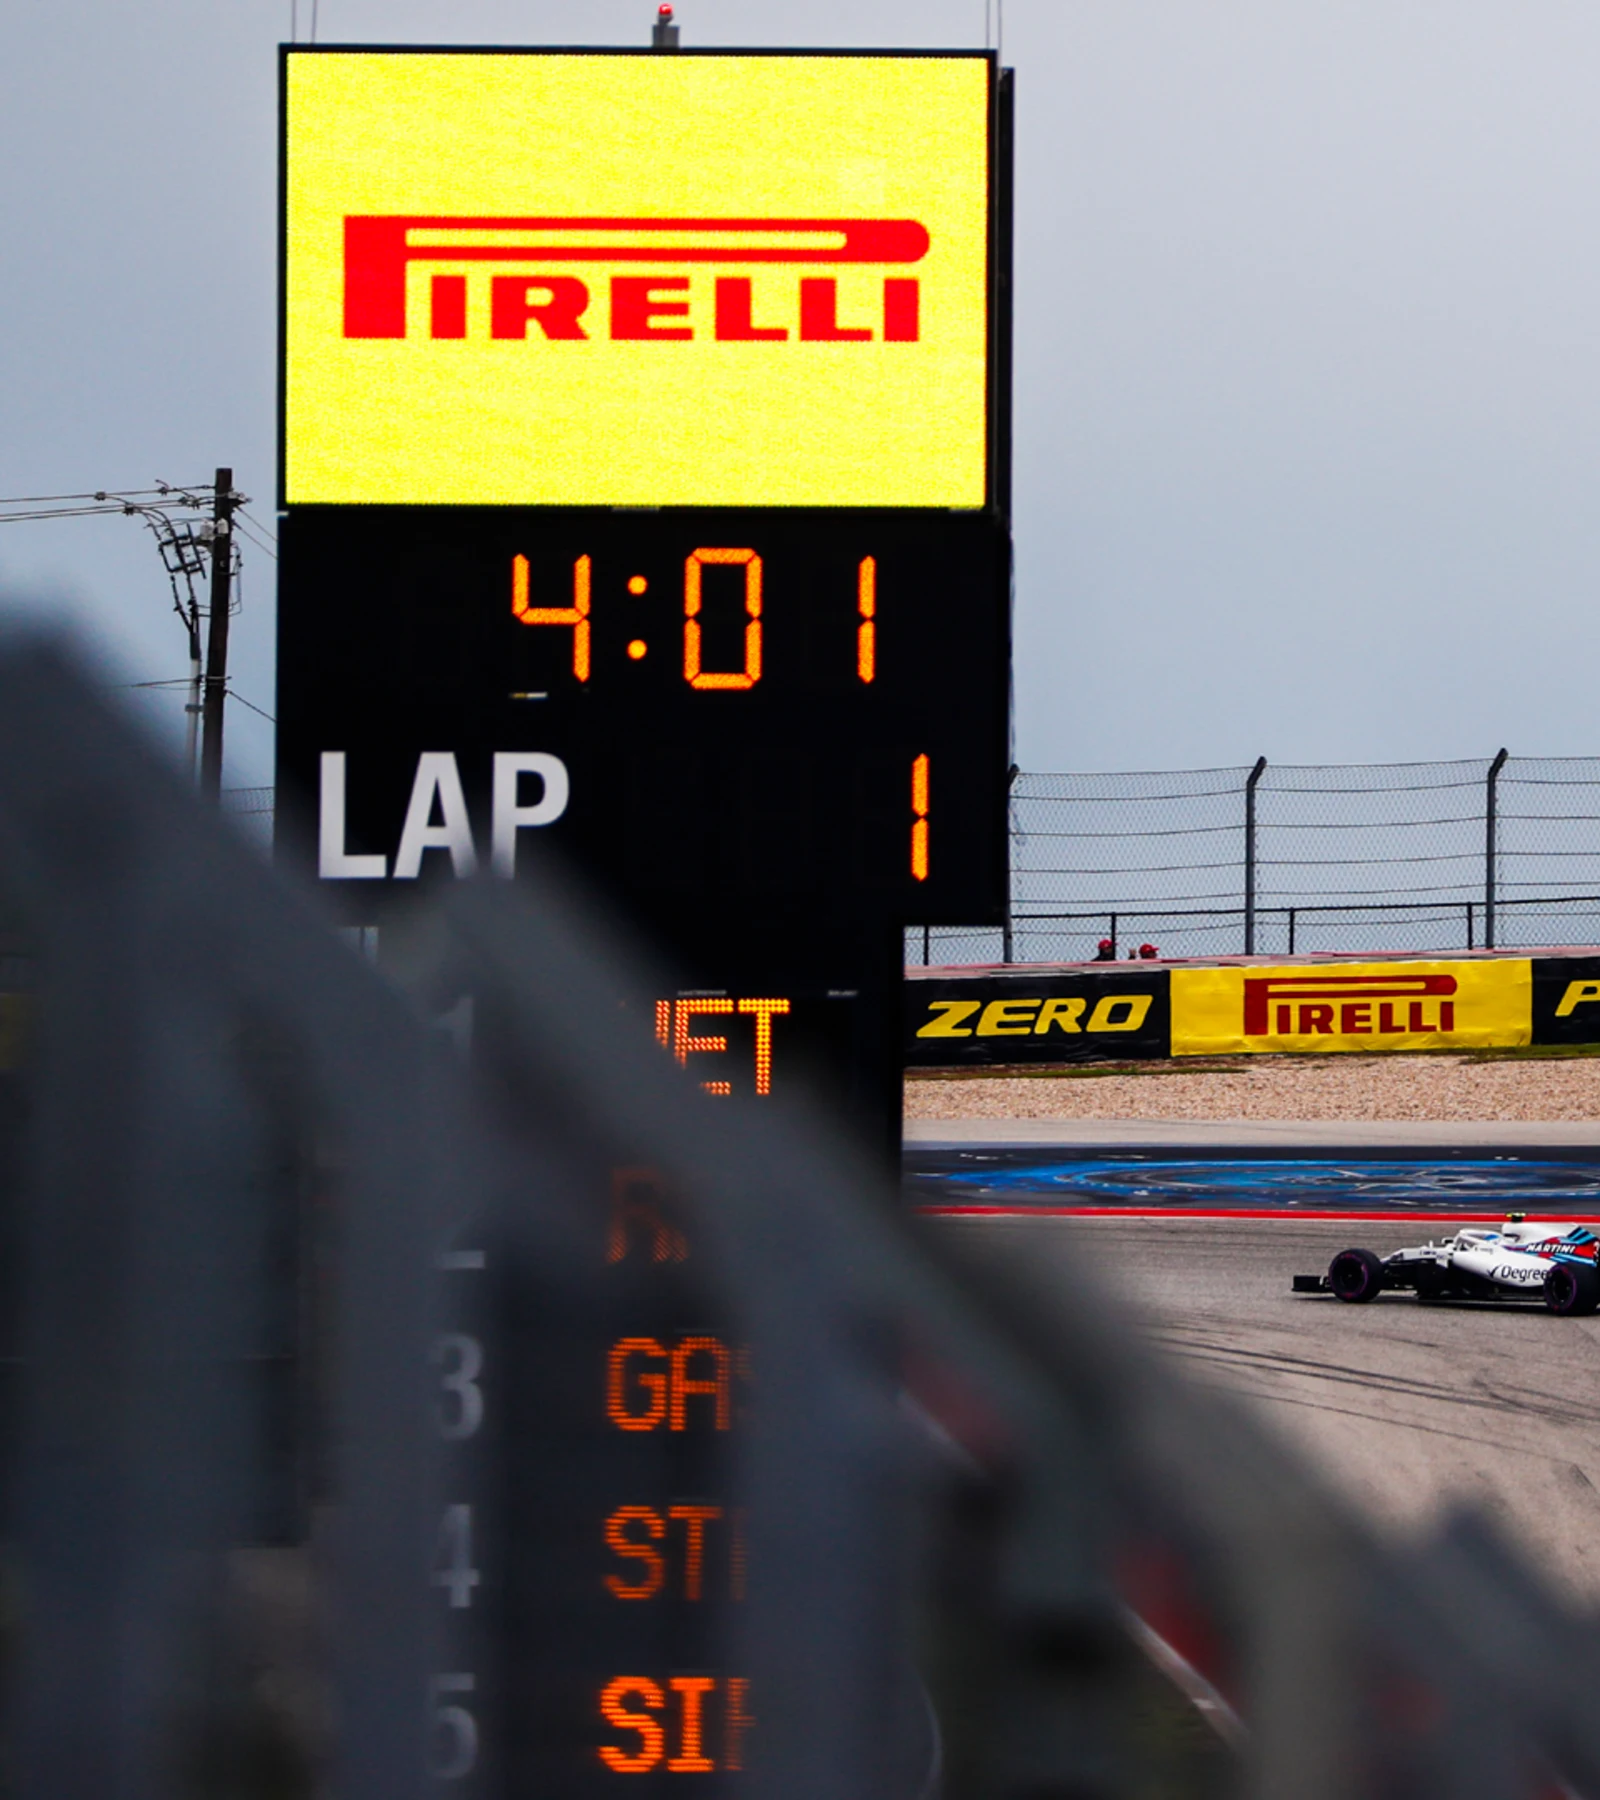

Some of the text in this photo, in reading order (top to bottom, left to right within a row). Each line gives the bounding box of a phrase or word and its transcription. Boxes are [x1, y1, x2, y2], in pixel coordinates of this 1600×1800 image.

[343, 215, 930, 342] PIRELLI
[512, 547, 877, 689] 4:01
[319, 751, 930, 881] LAP 1
[656, 998, 791, 1095] ET
[916, 994, 1154, 1038] ZERO
[1244, 974, 1458, 1036] PIRELLI
[1501, 1265, 1549, 1284] Degree
[1525, 1243, 1576, 1253] MARTINI
[606, 1337, 752, 1432] GA
[604, 1505, 748, 1601] ST
